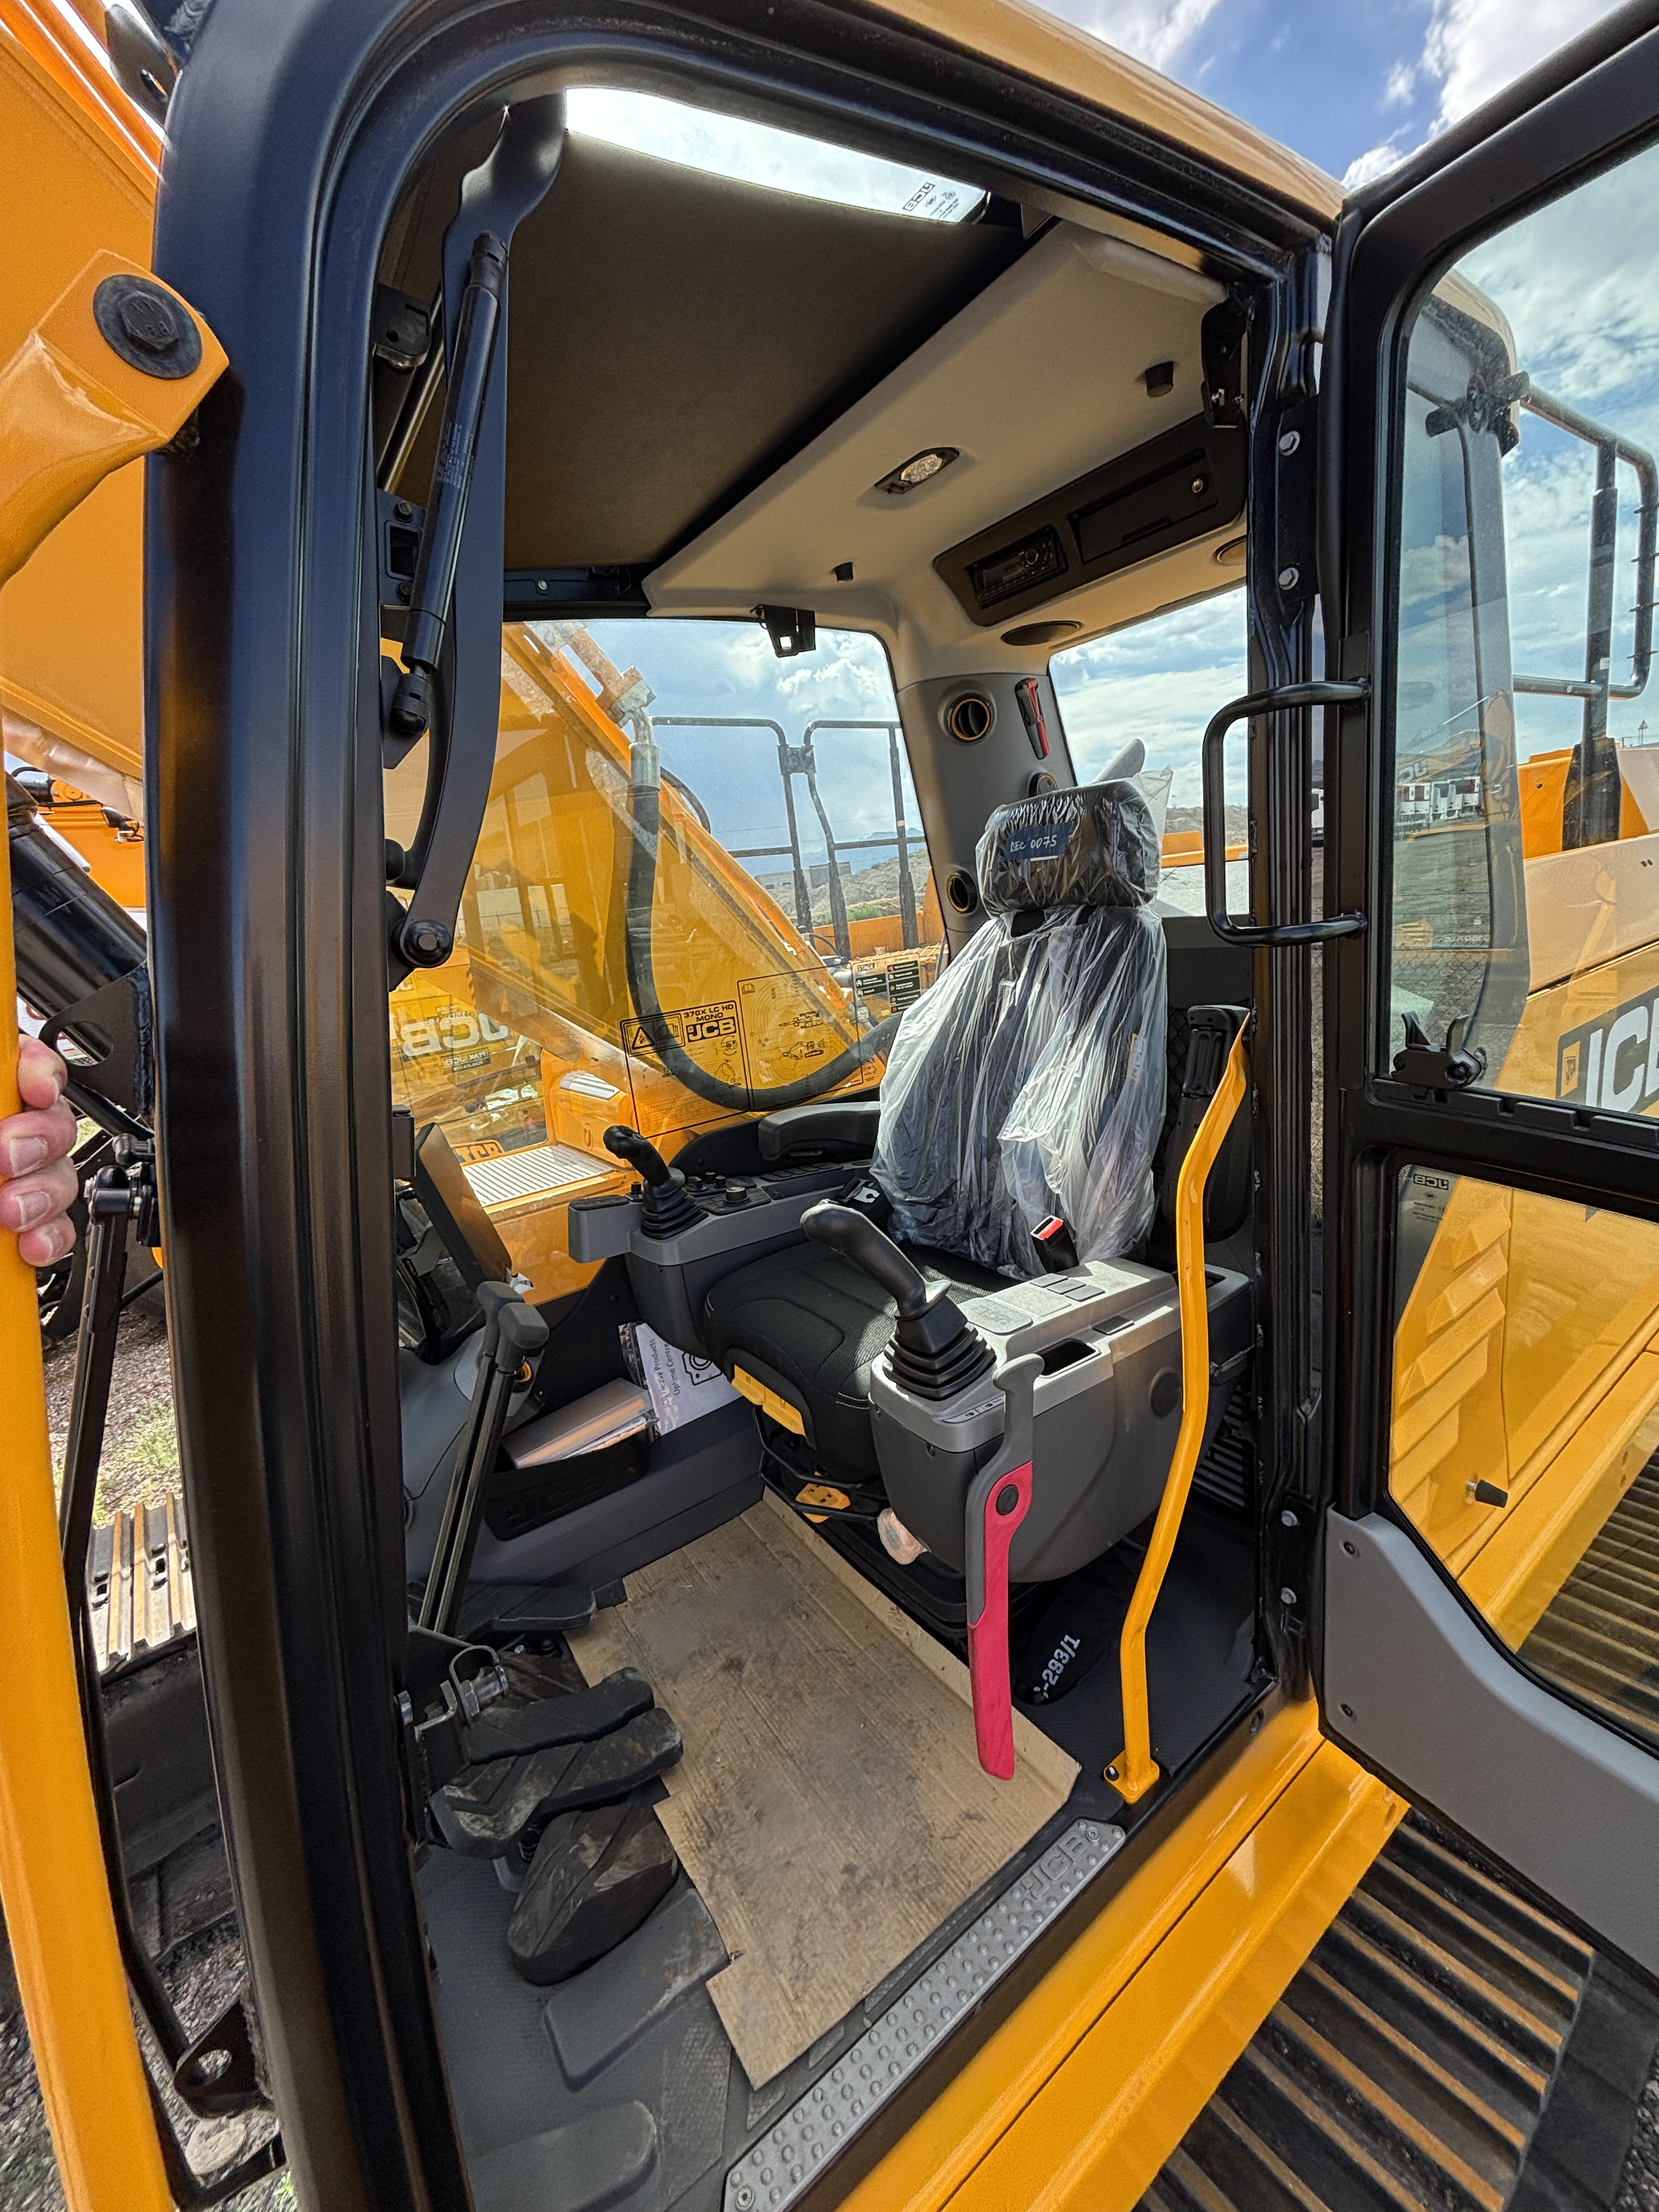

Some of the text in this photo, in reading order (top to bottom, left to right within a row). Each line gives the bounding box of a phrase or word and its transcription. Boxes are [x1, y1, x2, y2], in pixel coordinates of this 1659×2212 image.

[1030, 834, 1058, 849] 0075
[857, 963, 874, 972] STAGE
[684, 1009, 707, 1018] 370X
[721, 1003, 734, 1012] HD
[696, 1012, 724, 1023] MONO
[687, 1018, 736, 1042] JCB
[650, 1339, 661, 1371] Products
[664, 1343, 680, 1395] Uptime Centre
[1021, 1836, 1089, 1900] JCB
